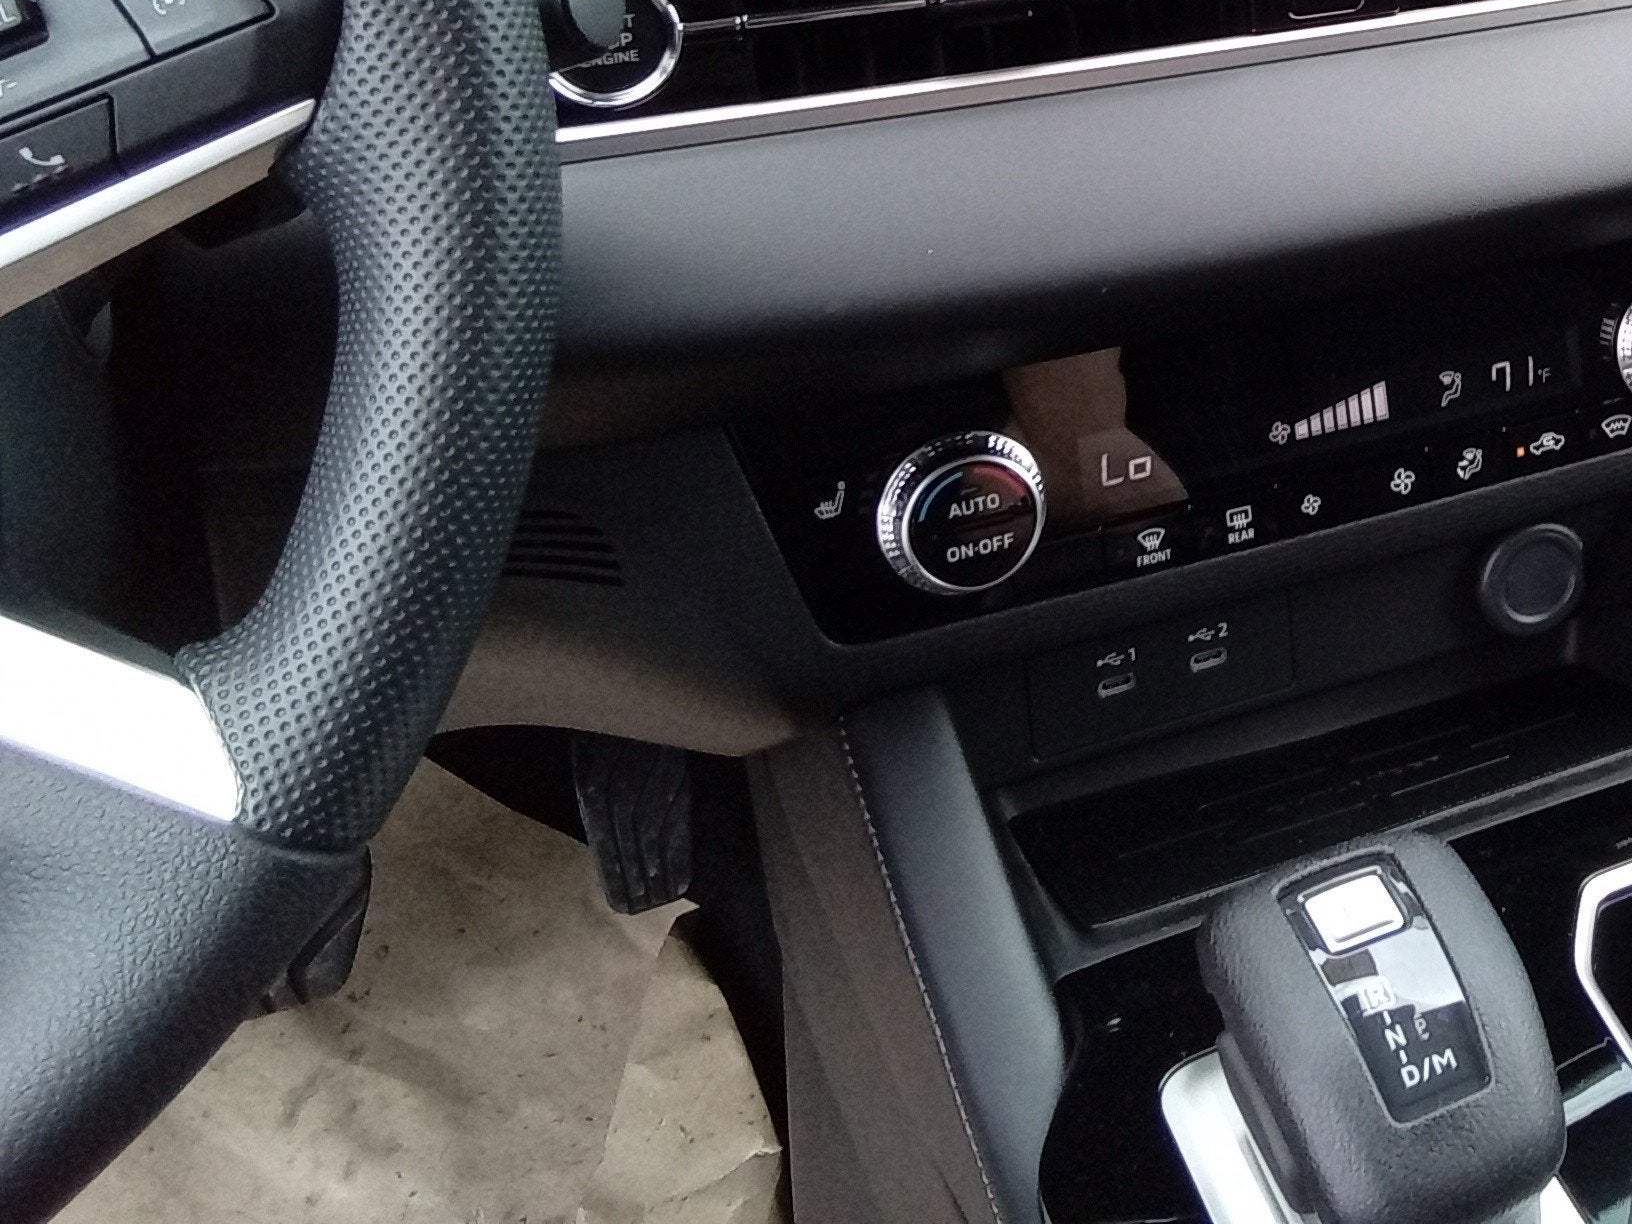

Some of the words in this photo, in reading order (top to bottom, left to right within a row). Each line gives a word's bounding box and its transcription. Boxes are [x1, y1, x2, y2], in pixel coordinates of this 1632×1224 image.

[1100, 454, 1151, 487] Lo
[949, 493, 1000, 520] AUTO
[1227, 527, 1255, 545] REAR
[1136, 547, 1172, 568] FRONT
[1216, 622, 1229, 638] 2
[1127, 647, 1137, 662] 1
[1384, 1023, 1408, 1052] N
[1400, 1047, 1458, 1090] D/M
